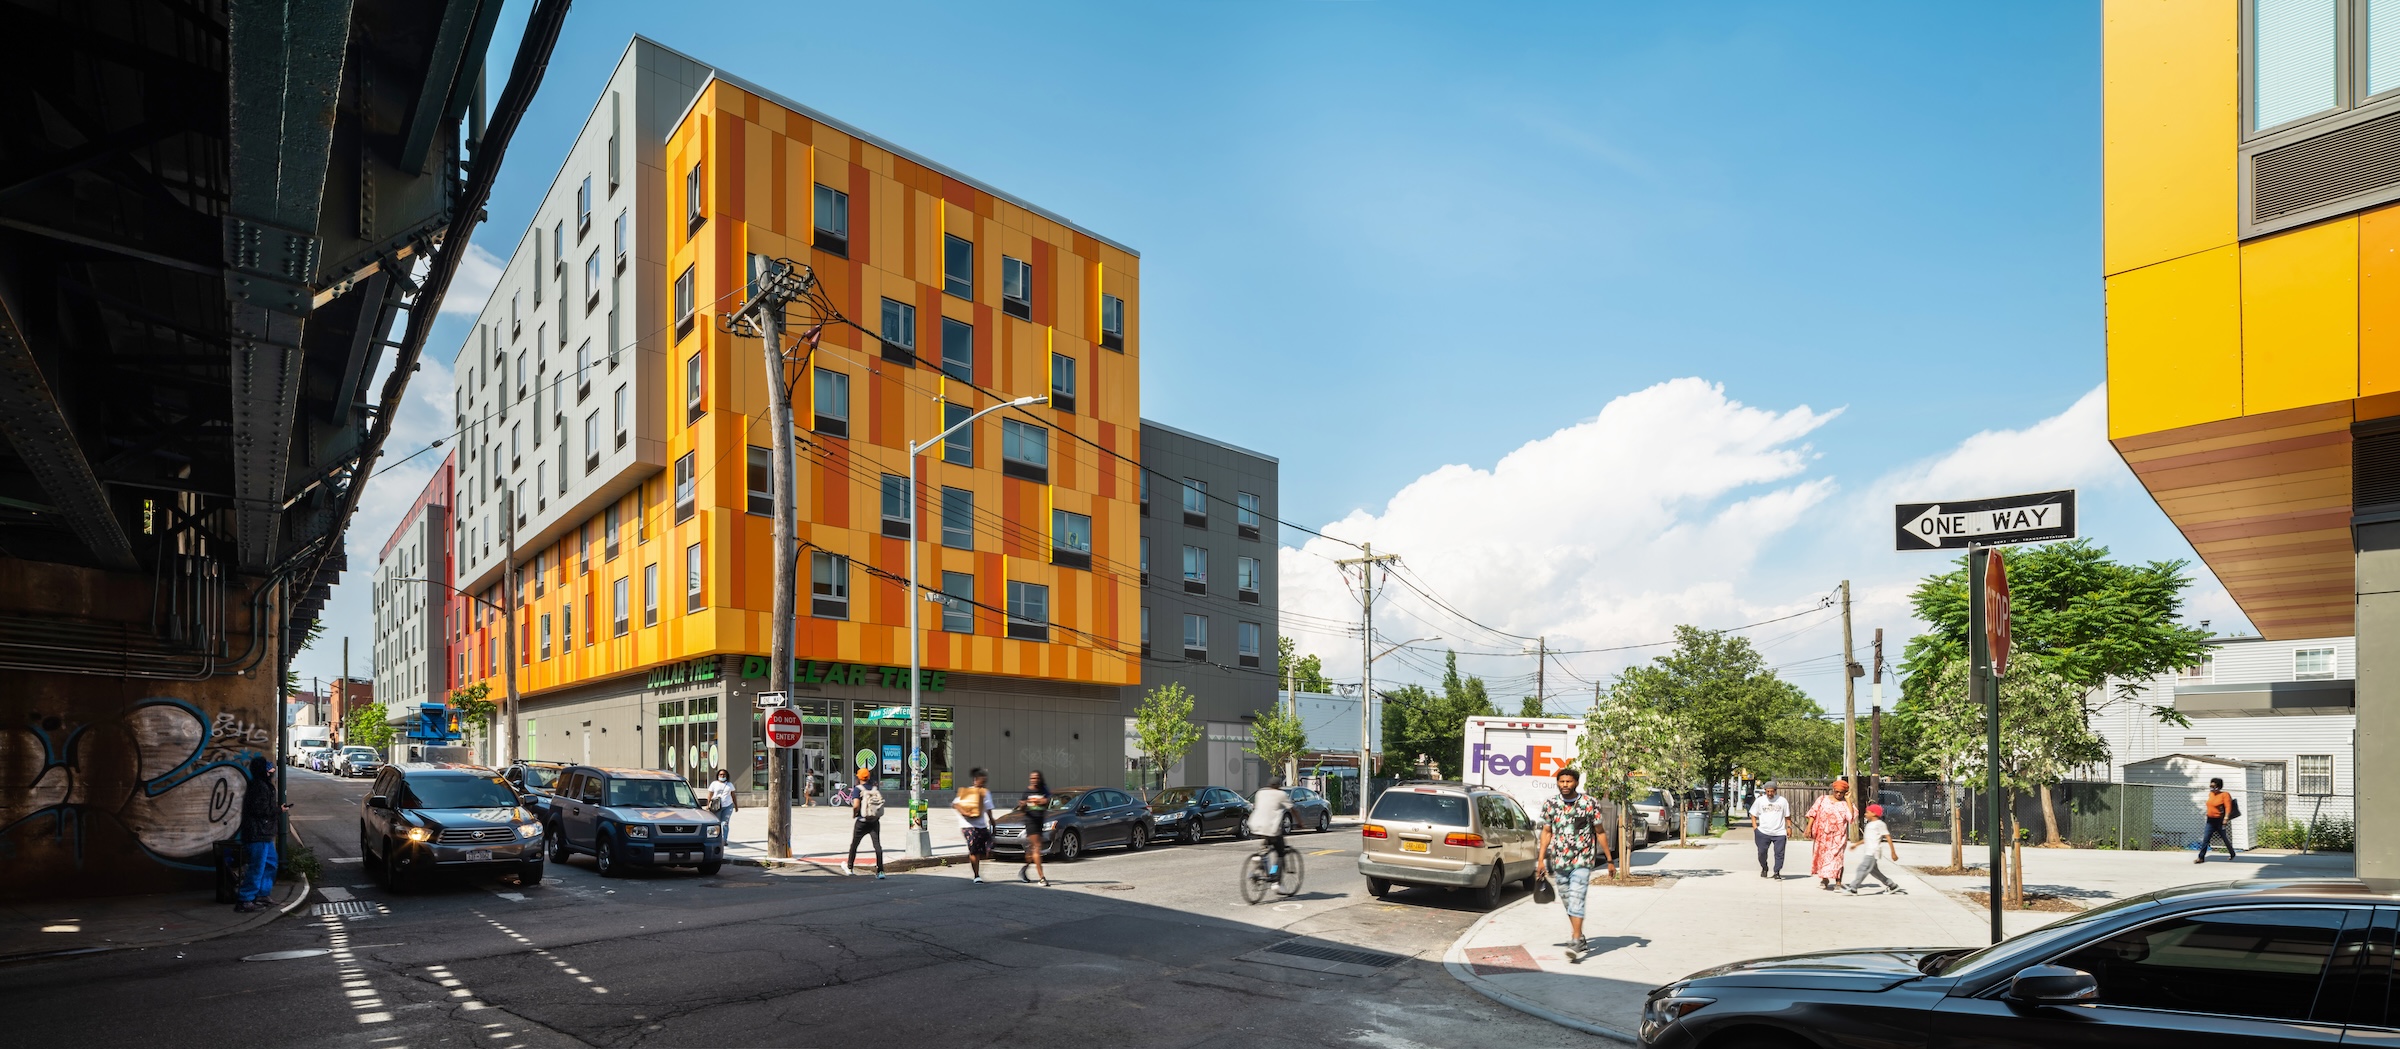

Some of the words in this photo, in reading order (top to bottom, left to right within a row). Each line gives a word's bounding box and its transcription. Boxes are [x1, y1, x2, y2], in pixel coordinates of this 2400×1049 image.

[1920, 515, 1966, 536] ONE
[1992, 507, 2049, 531] WAY
[2022, 534, 2068, 542] TRANSPORTATION
[1987, 585, 2009, 638] STOP
[647, 661, 686, 689] DOLLAR
[689, 655, 715, 682] TREE
[741, 655, 868, 686] DLLAR
[878, 666, 948, 692] TREE
[784, 716, 797, 724] NOT
[870, 710, 881, 718] Van
[775, 733, 796, 741] ENTER
[1472, 743, 1576, 778] FedEx
